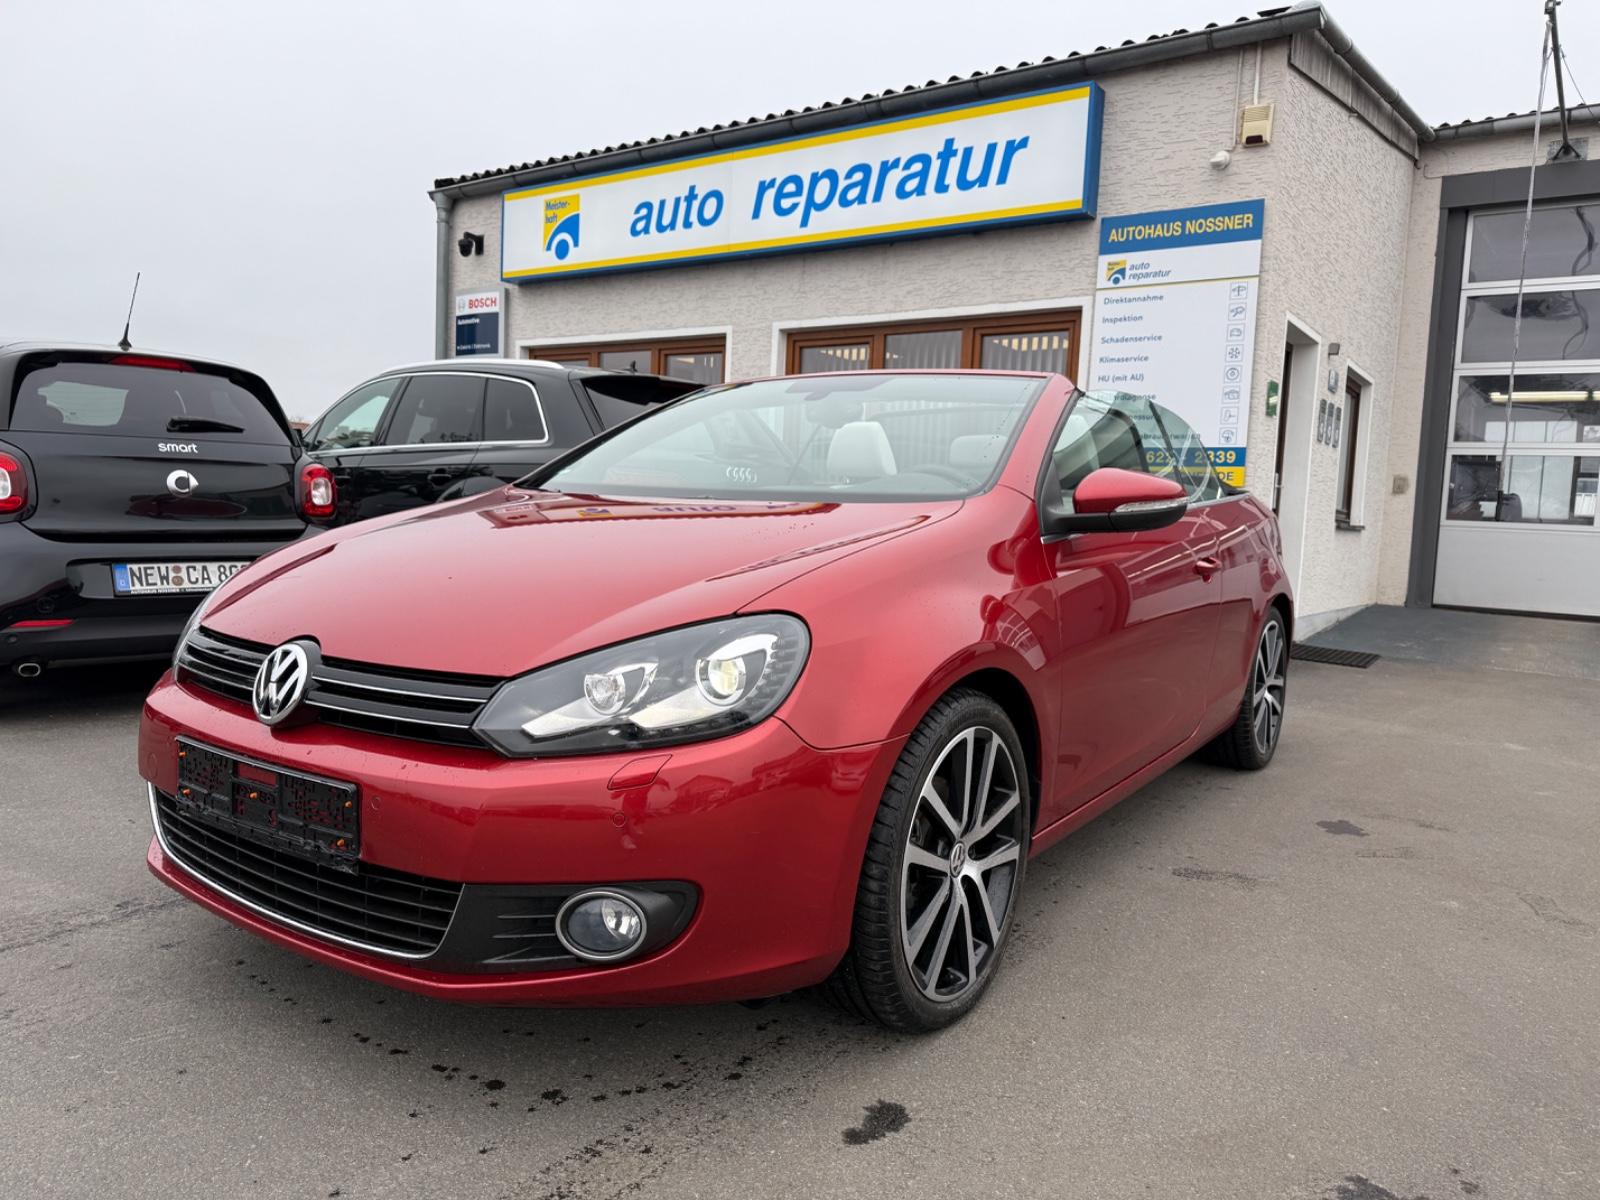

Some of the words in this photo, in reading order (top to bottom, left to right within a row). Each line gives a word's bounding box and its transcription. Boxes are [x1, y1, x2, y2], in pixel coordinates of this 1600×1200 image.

[630, 185, 724, 237] auto
[751, 136, 1030, 228] reparatur
[1108, 221, 1182, 243] AUTOHAUS
[1186, 213, 1254, 235] NOSSNER
[1129, 262, 1151, 271] auto
[1128, 270, 1172, 281] reparatur
[468, 297, 497, 309] BOSCH
[1104, 294, 1164, 305] Direktannahme
[1102, 314, 1143, 324] Inspektion
[1101, 333, 1163, 344] Schadenservice
[1099, 355, 1149, 364] Klimaservice
[1098, 375, 1110, 383] HU
[1112, 374, 1128, 383] (mit
[1130, 373, 1144, 382] AU)
[158, 442, 198, 453] smart
[129, 566, 170, 587] NEW
[186, 564, 212, 585] CA
